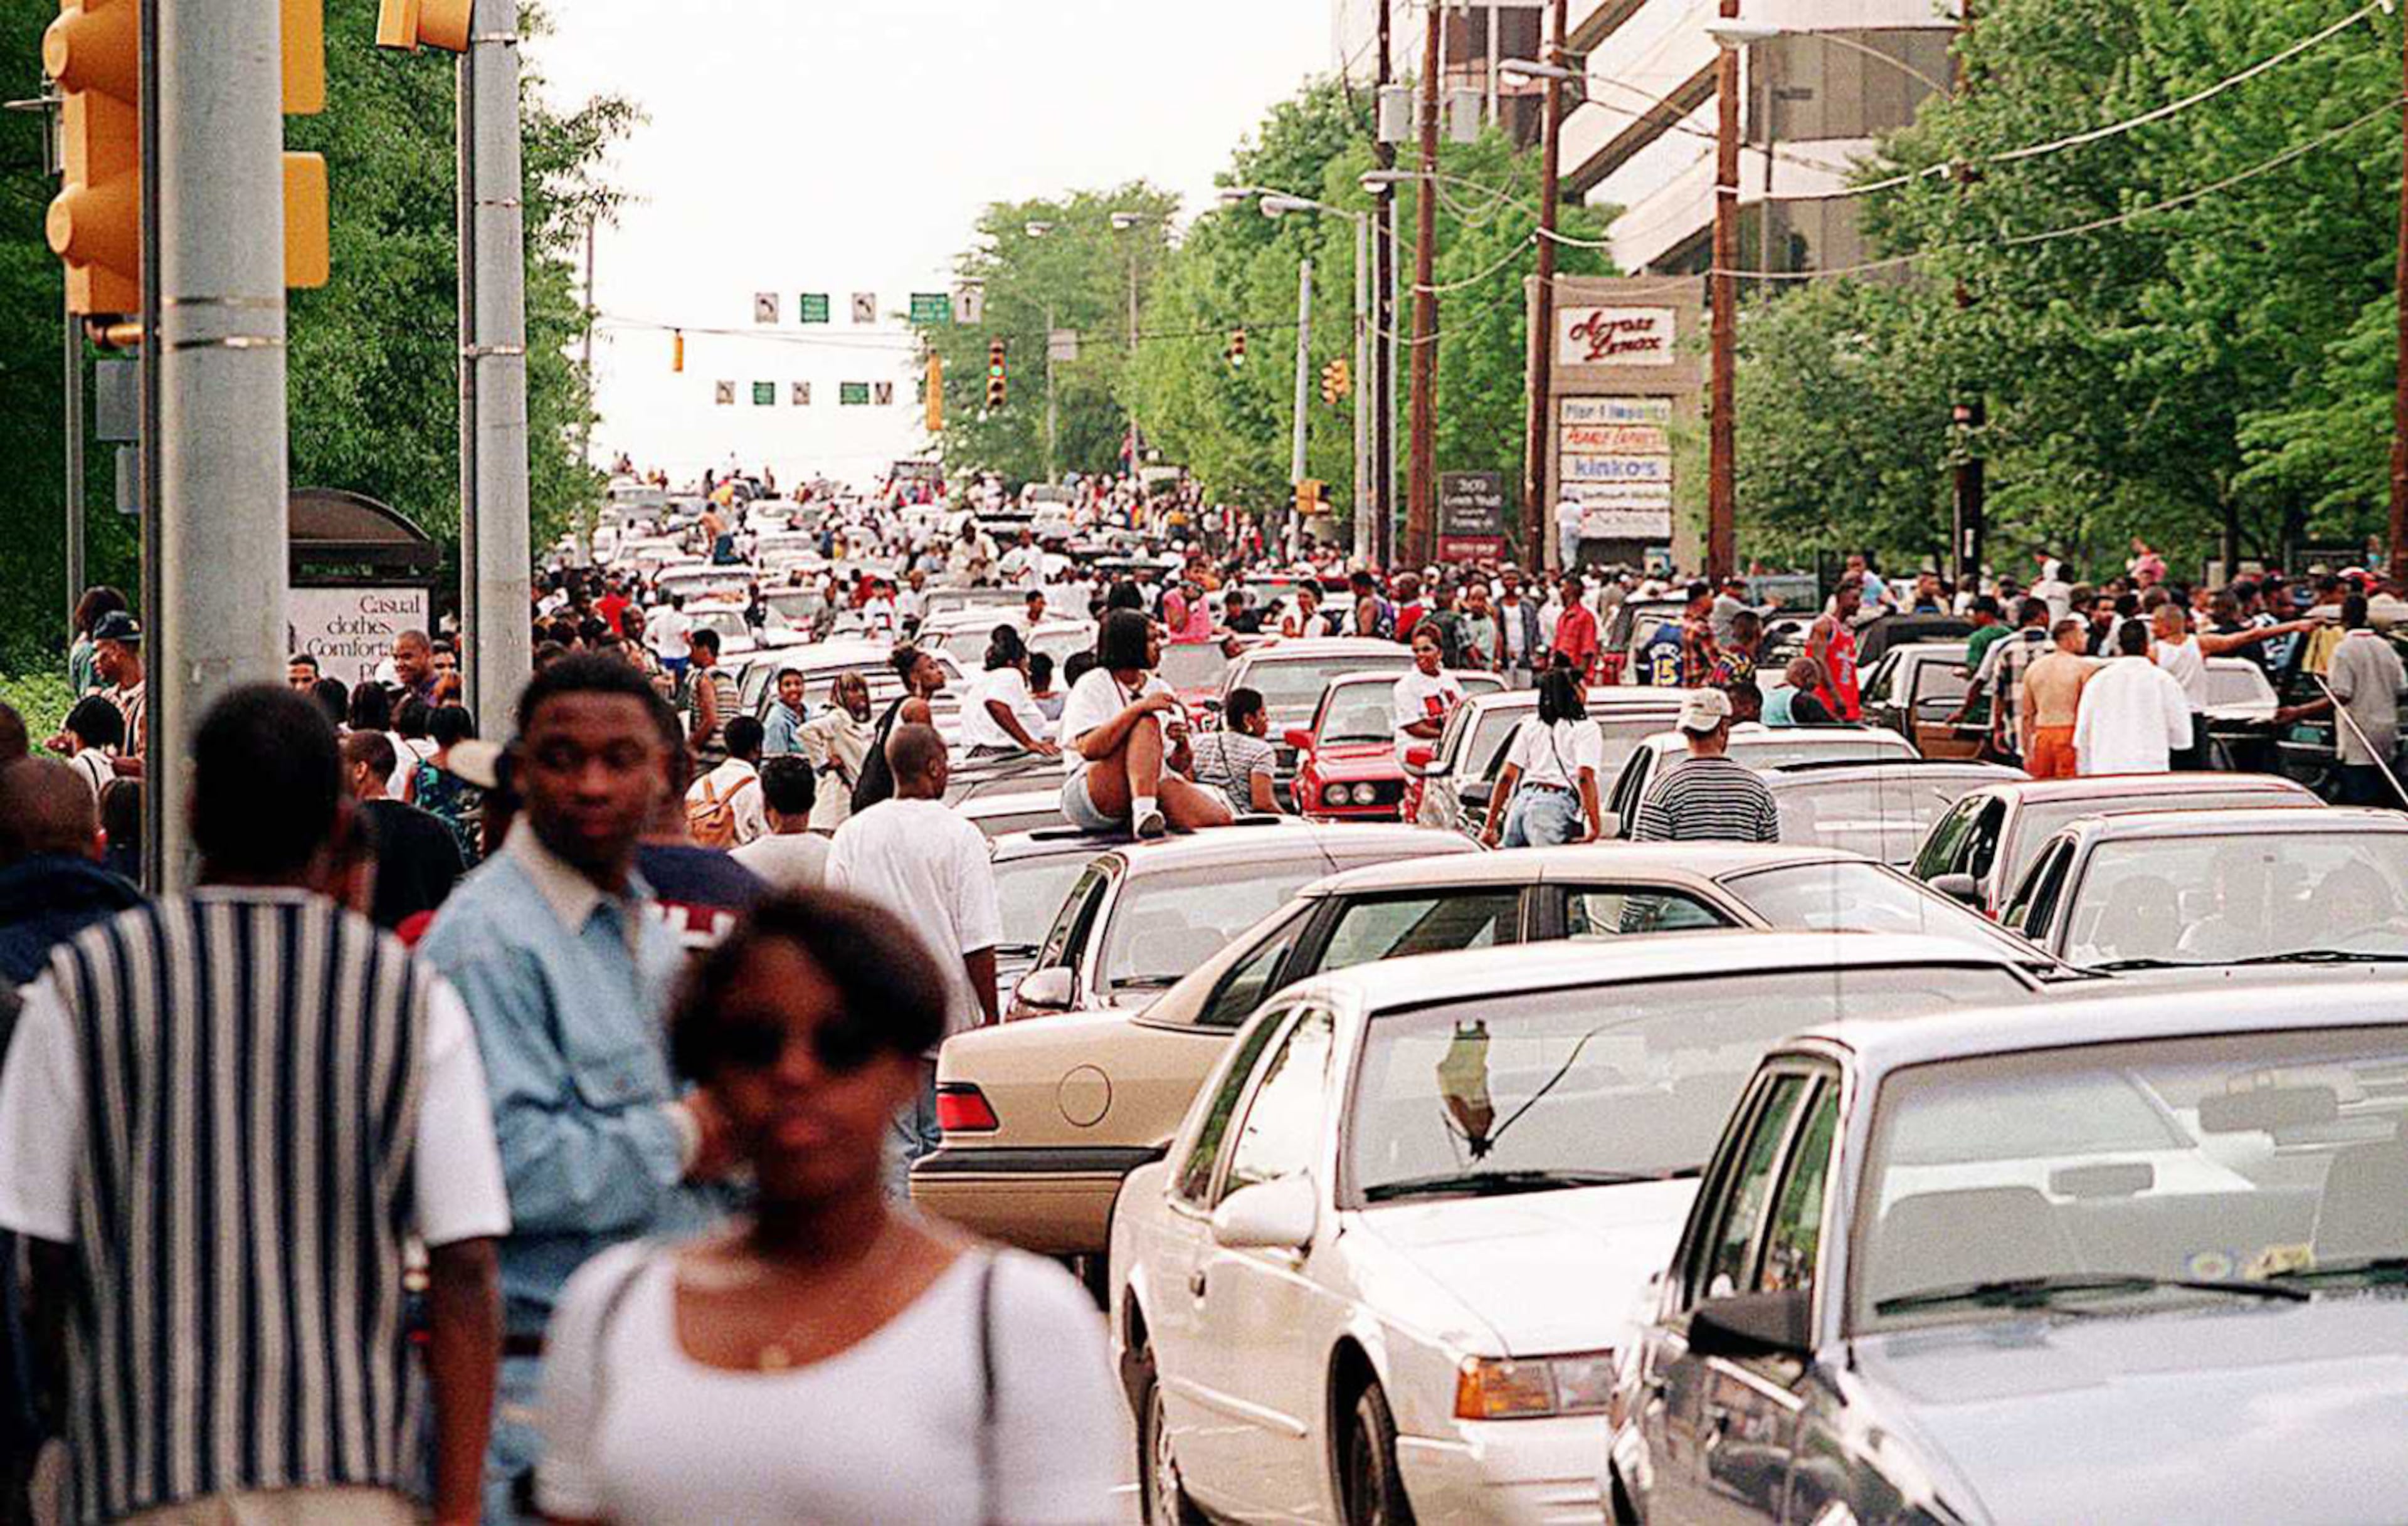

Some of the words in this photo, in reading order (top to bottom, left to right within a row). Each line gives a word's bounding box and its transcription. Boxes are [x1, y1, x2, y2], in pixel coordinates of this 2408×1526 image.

[1570, 312, 1654, 344] Across
[1584, 330, 1662, 362] Lenox
[359, 595, 420, 613] Casual
[1652, 658, 1679, 686] 15
